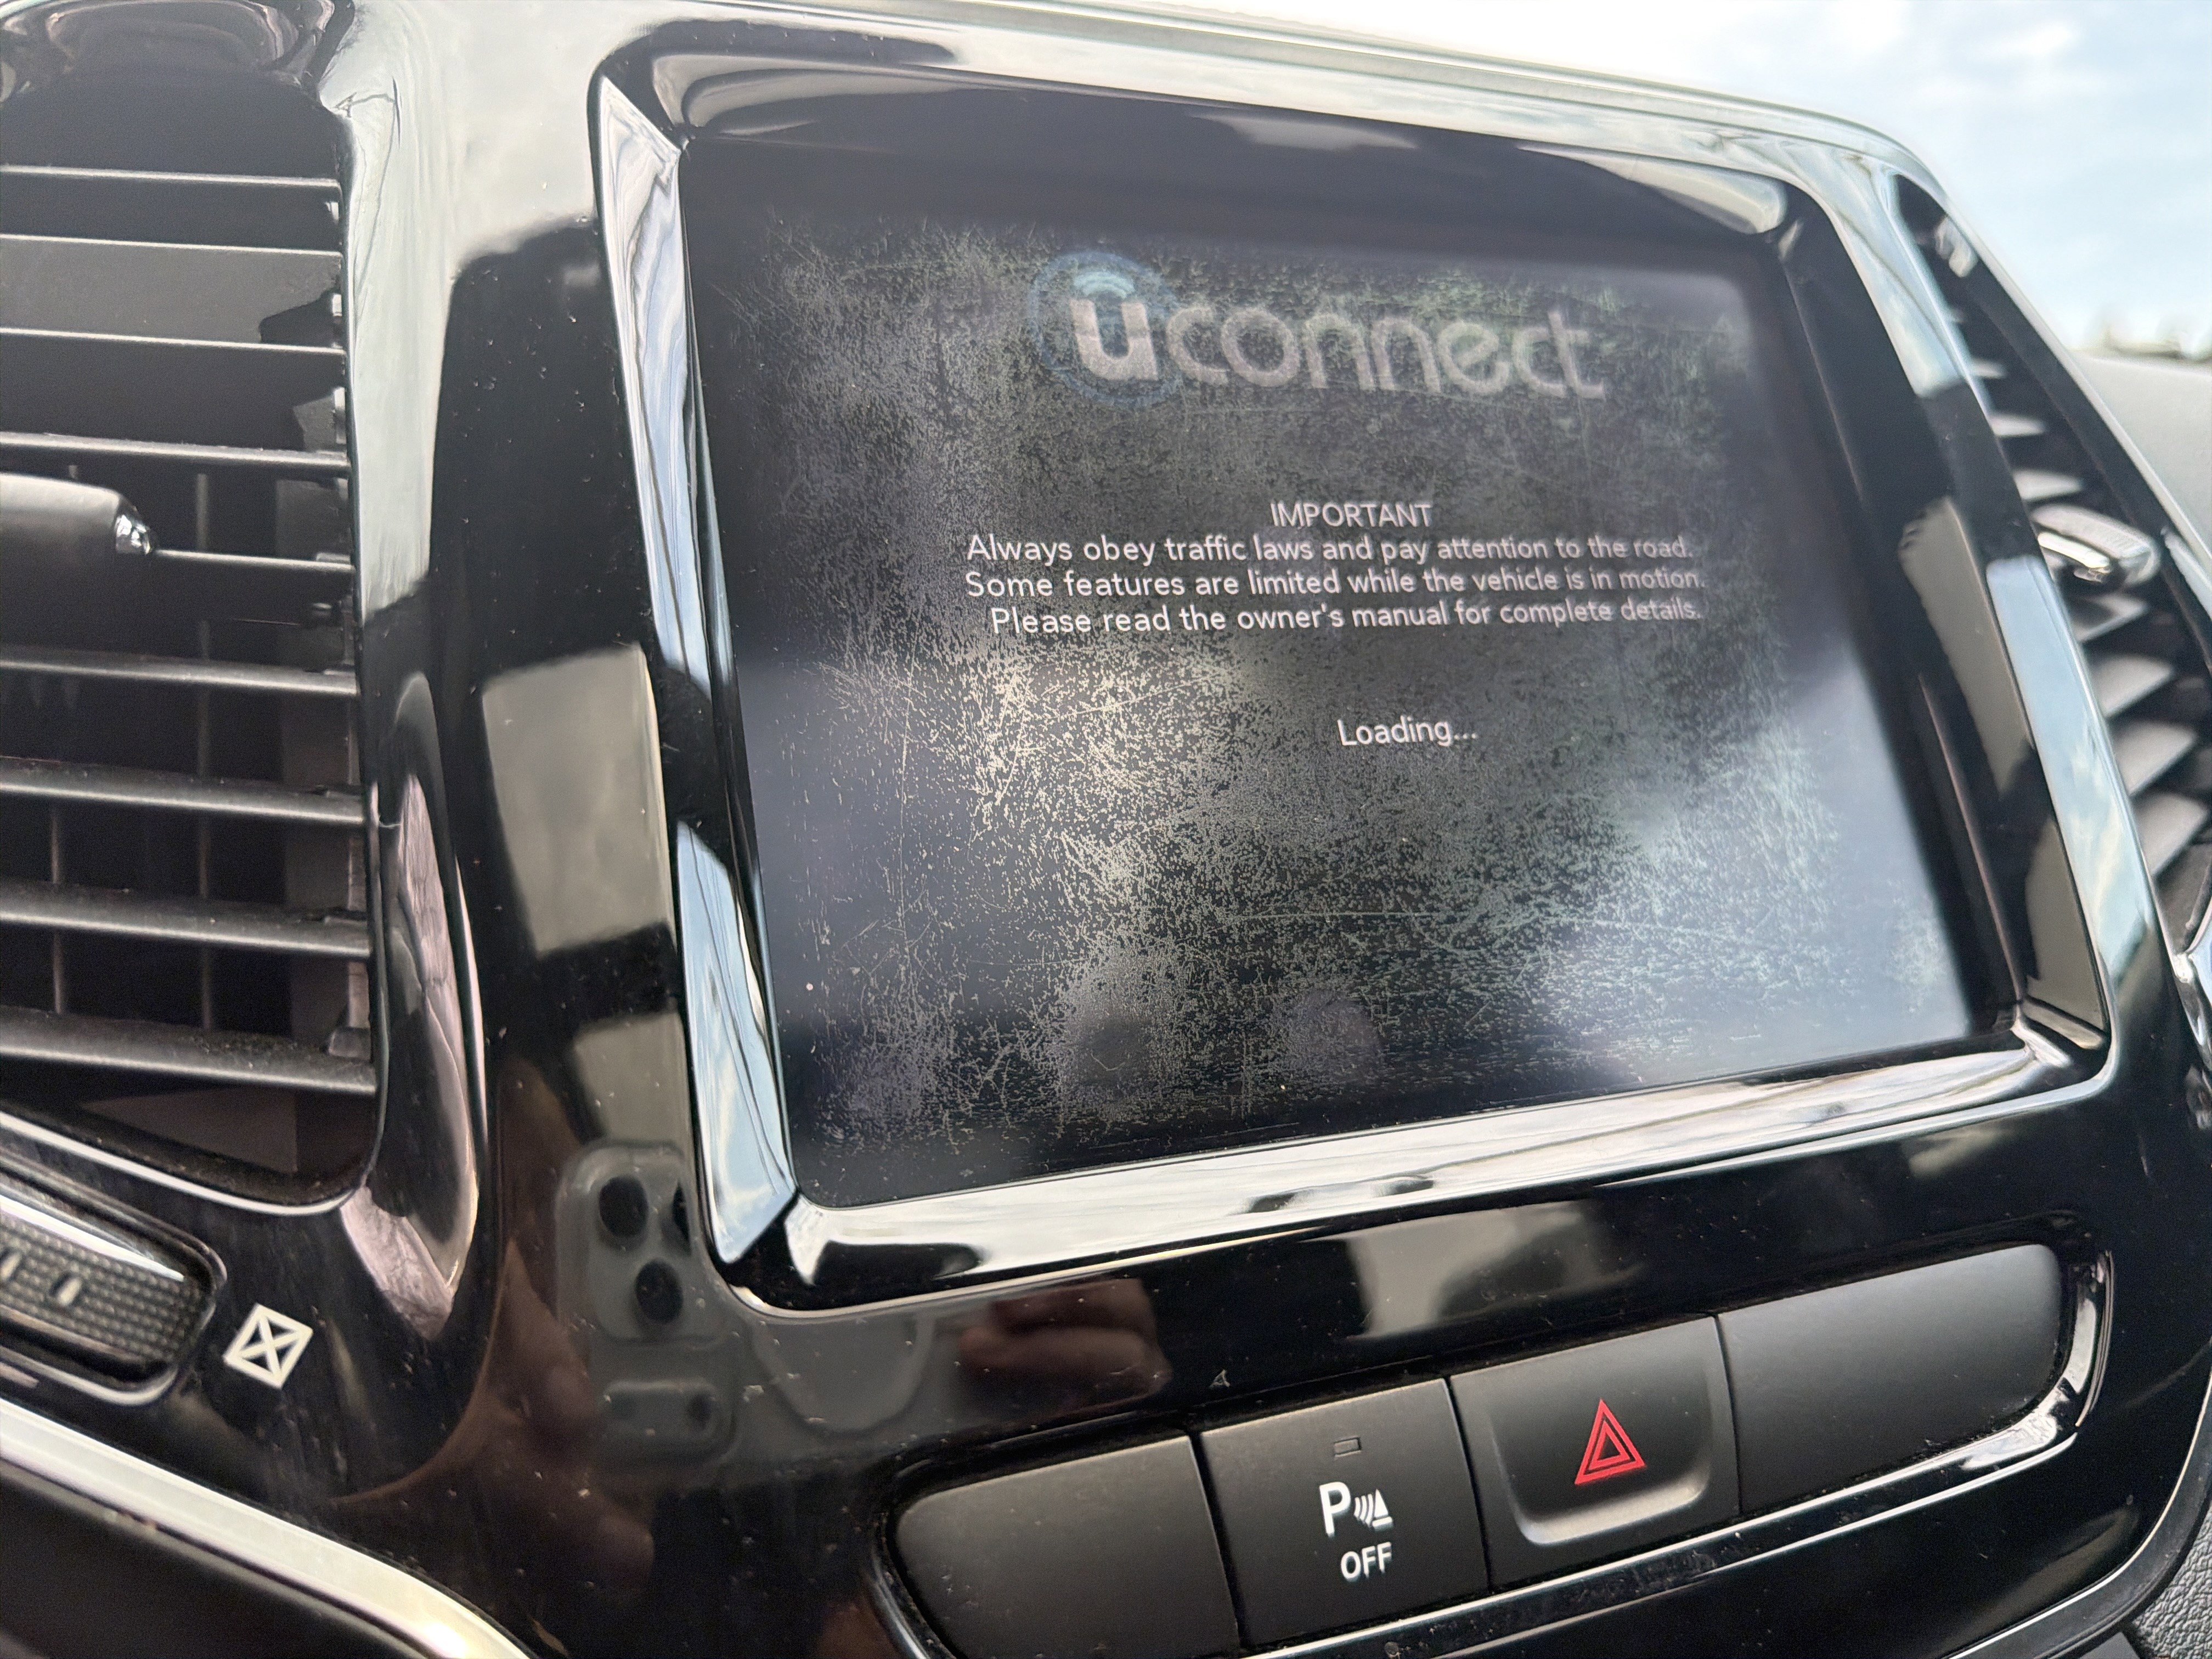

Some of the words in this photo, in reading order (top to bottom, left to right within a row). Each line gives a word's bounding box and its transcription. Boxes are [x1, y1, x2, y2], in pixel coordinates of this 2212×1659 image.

[1069, 298, 1605, 399] uconnect
[1270, 501, 1431, 528] IMPORTANT
[967, 534, 1073, 566] Always
[1084, 534, 1155, 566] obey
[1164, 535, 1246, 560] traffic
[1252, 534, 1314, 560] laws
[1324, 535, 1372, 560] and
[1381, 541, 1428, 565] pay
[1437, 535, 1547, 559] attention
[1555, 537, 1582, 558] to
[1588, 535, 1628, 558] the
[1633, 534, 1694, 558] road.
[966, 572, 1053, 597] Some
[1063, 571, 1185, 596] features
[1195, 576, 1239, 595] are
[1248, 569, 1341, 595] limited
[1347, 567, 1415, 593] while
[1421, 567, 1465, 592] the
[1471, 566, 1560, 591] vehicle
[1564, 566, 1584, 590] is
[1589, 566, 1613, 590] in
[990, 606, 1092, 634] Please
[1103, 605, 1171, 633] read
[1179, 605, 1226, 631] the
[1237, 604, 1345, 631] owner's
[1352, 601, 1449, 628] manual
[1454, 601, 1492, 625] for
[1500, 598, 1612, 628] complete
[1621, 596, 1702, 621] details.
[1338, 715, 1477, 747] Loading...
[1340, 1541, 1392, 1582] OFF
